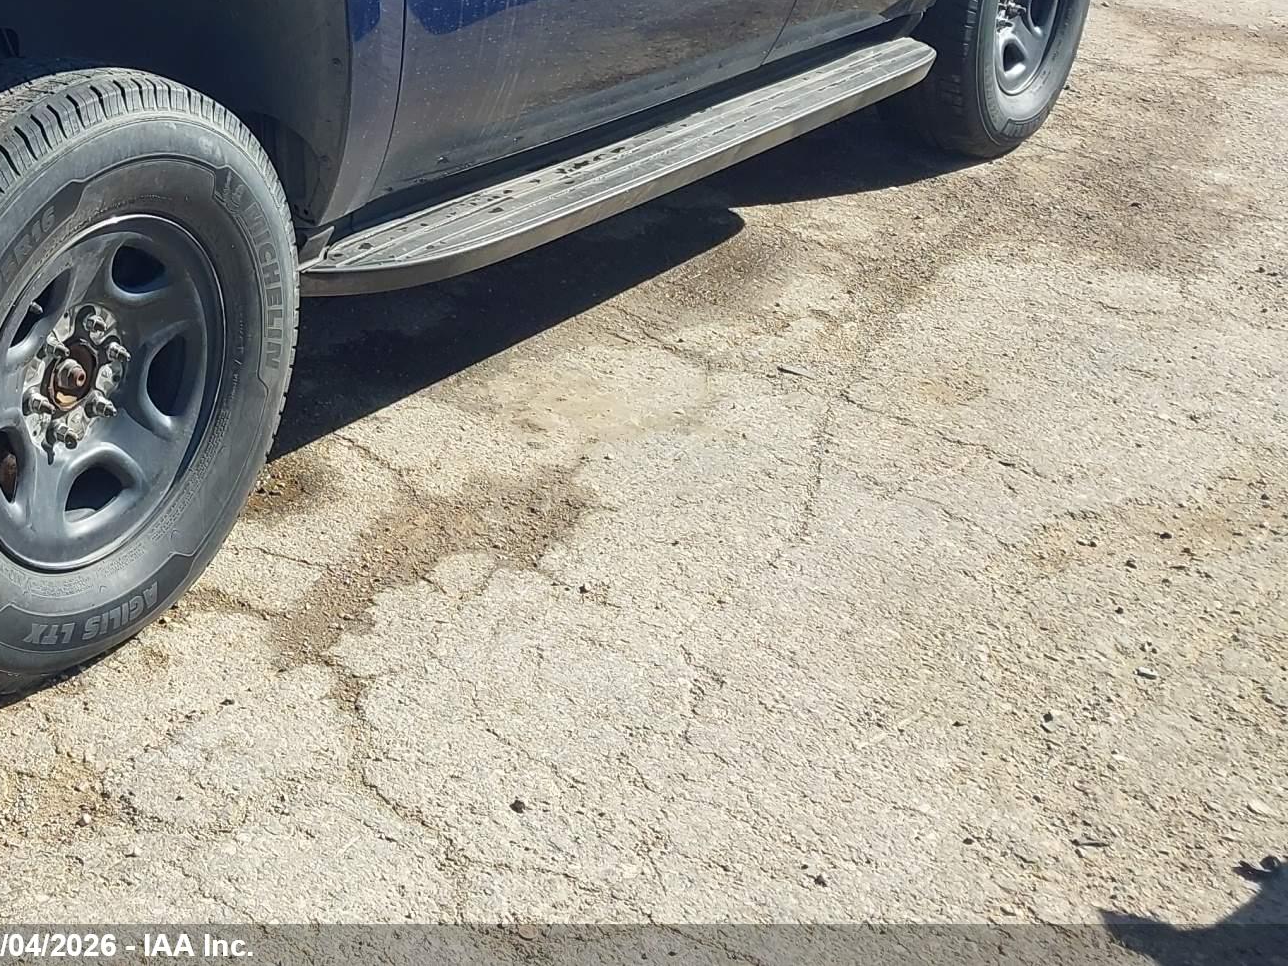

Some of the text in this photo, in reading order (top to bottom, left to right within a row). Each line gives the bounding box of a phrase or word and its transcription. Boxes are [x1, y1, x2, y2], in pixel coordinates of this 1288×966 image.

[245, 200, 285, 370] MICHELIN
[23, 581, 158, 645] AGILIS LTX
